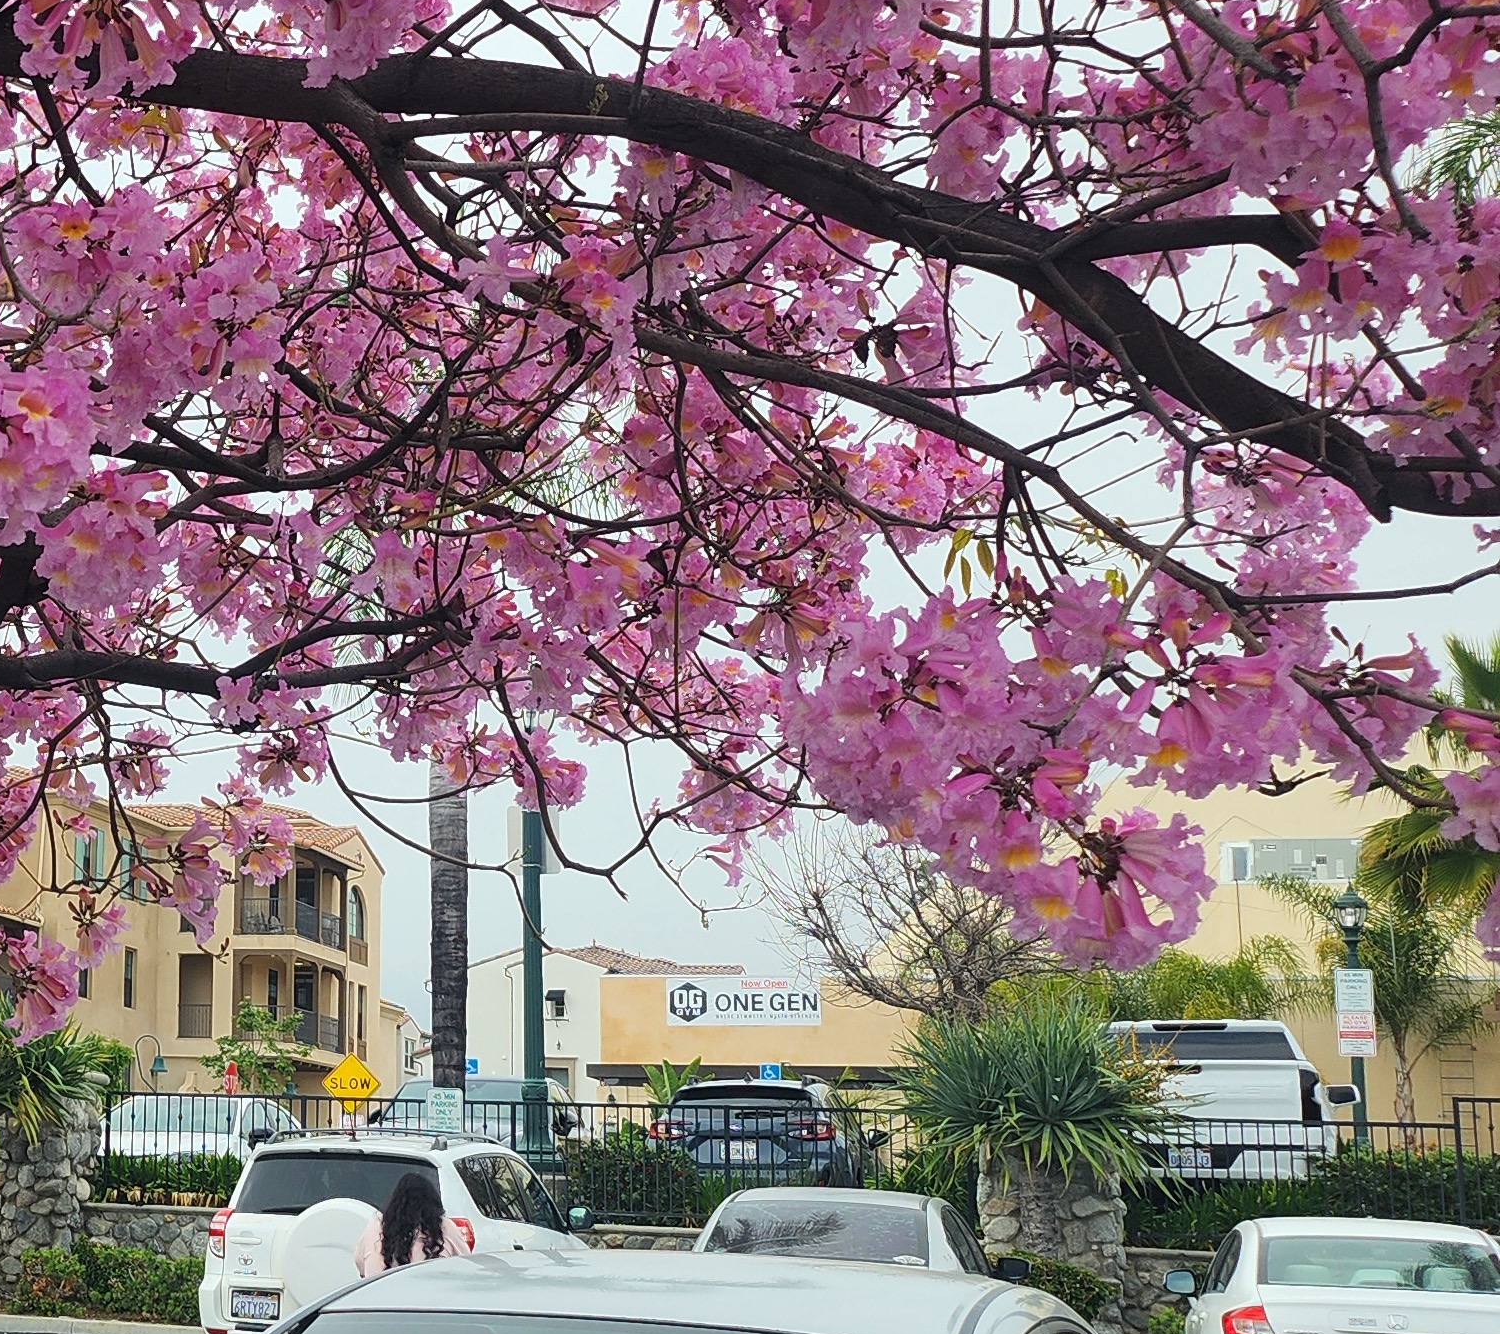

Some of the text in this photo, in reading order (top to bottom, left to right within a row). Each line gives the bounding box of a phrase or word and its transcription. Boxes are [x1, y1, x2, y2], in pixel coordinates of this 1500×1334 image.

[741, 979, 788, 990] Now Open
[673, 989, 703, 1009] OG
[715, 992, 818, 1012] ONE GEN
[675, 1007, 700, 1016] GYM
[329, 1077, 371, 1090] SLOW
[430, 1100, 458, 1108] PARKING
[435, 1108, 453, 1116] ONLY
